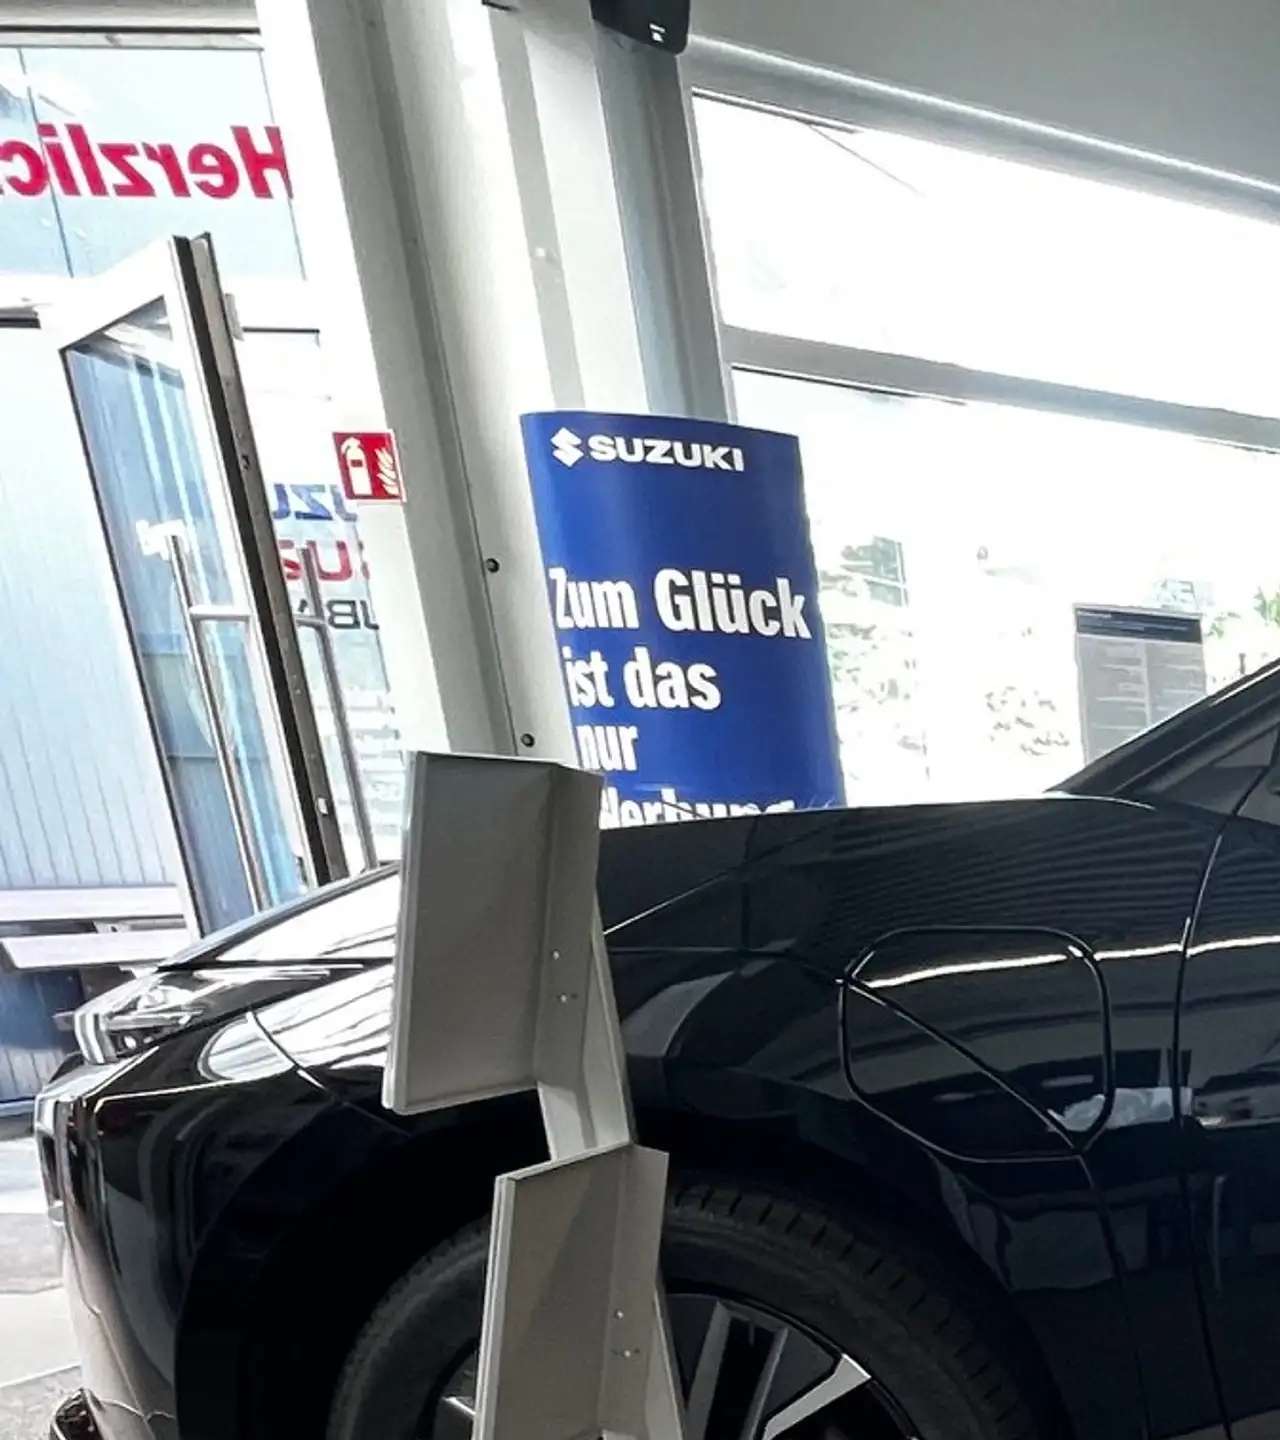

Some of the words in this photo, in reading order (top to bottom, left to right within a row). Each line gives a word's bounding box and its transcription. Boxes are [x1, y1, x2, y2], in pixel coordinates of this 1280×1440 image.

[587, 434, 745, 472] SUZUKI
[548, 566, 640, 630] Zum
[653, 567, 812, 639] Glück
[562, 646, 615, 708] ist
[623, 646, 722, 710] das
[575, 724, 639, 772] nur
